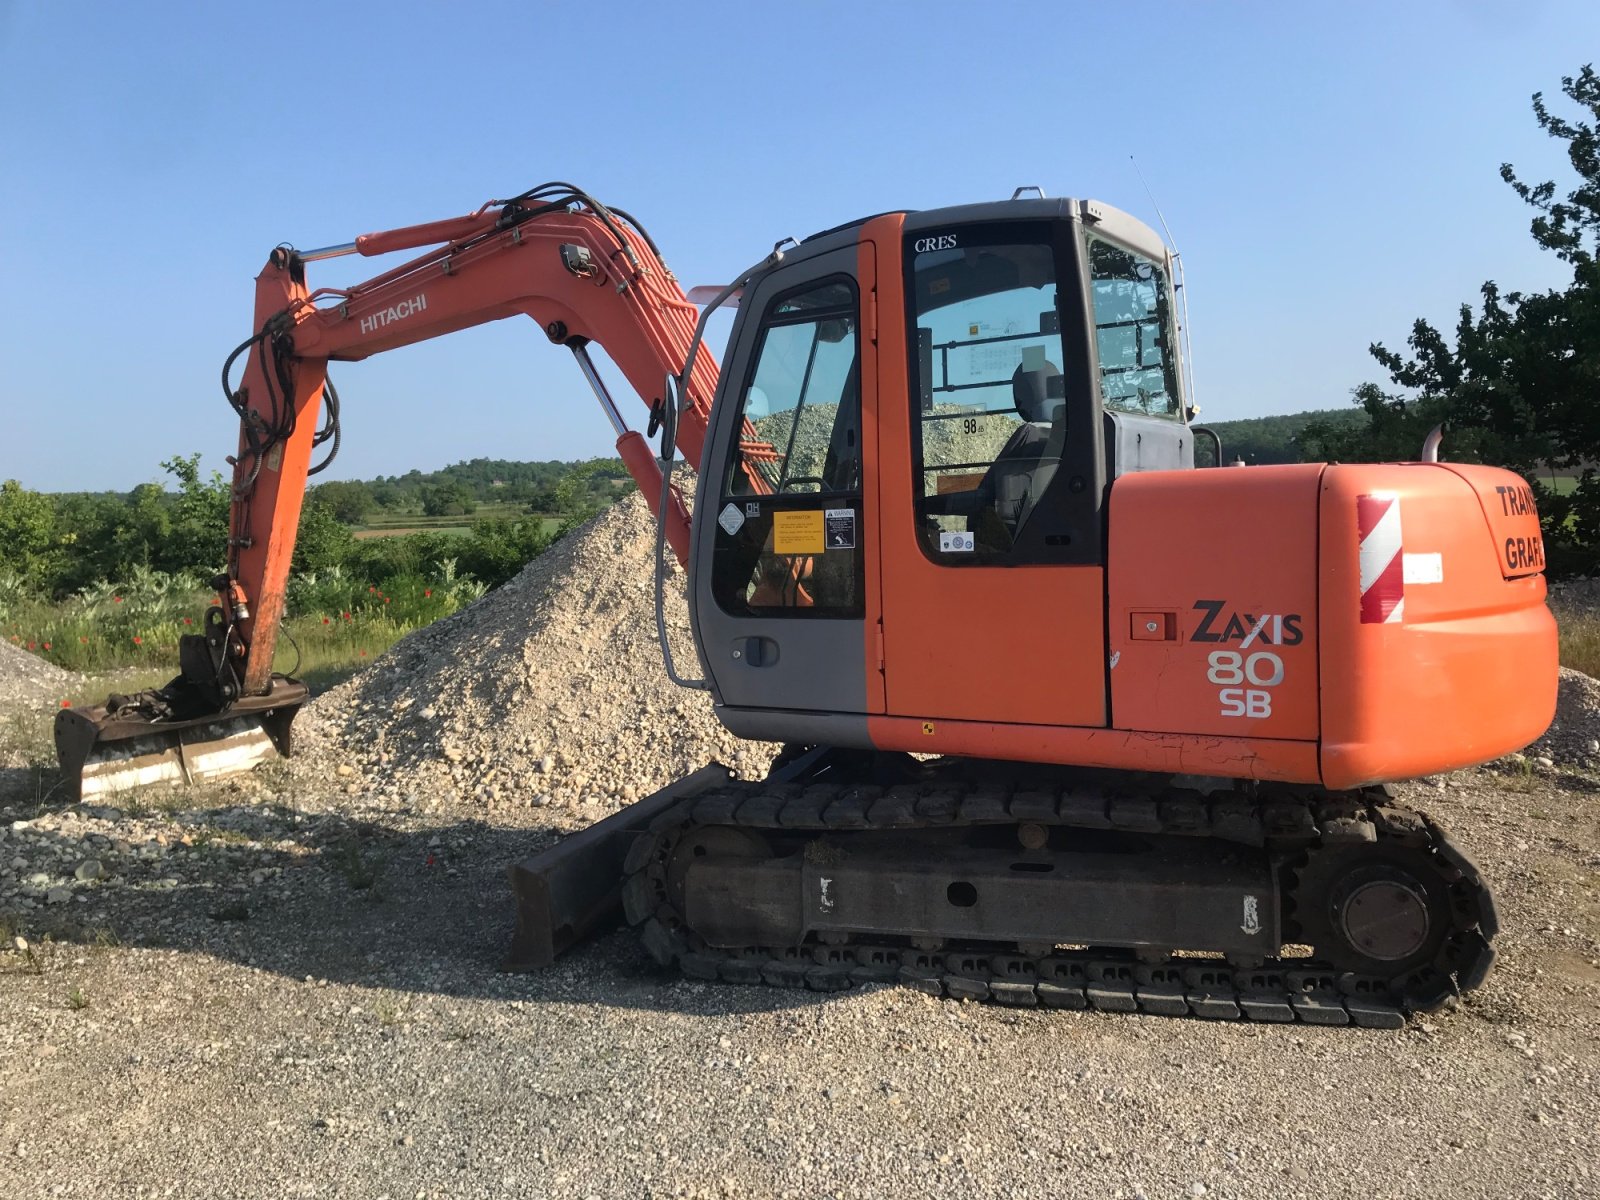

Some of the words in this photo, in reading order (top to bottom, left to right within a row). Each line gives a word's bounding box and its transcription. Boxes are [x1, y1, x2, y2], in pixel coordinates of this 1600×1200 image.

[915, 234, 957, 253] CRES
[360, 293, 427, 335] HITACHI
[963, 418, 977, 434] 98
[1189, 599, 1304, 649] ZAXIS
[1207, 650, 1285, 687] 80
[1219, 688, 1272, 718] SB
